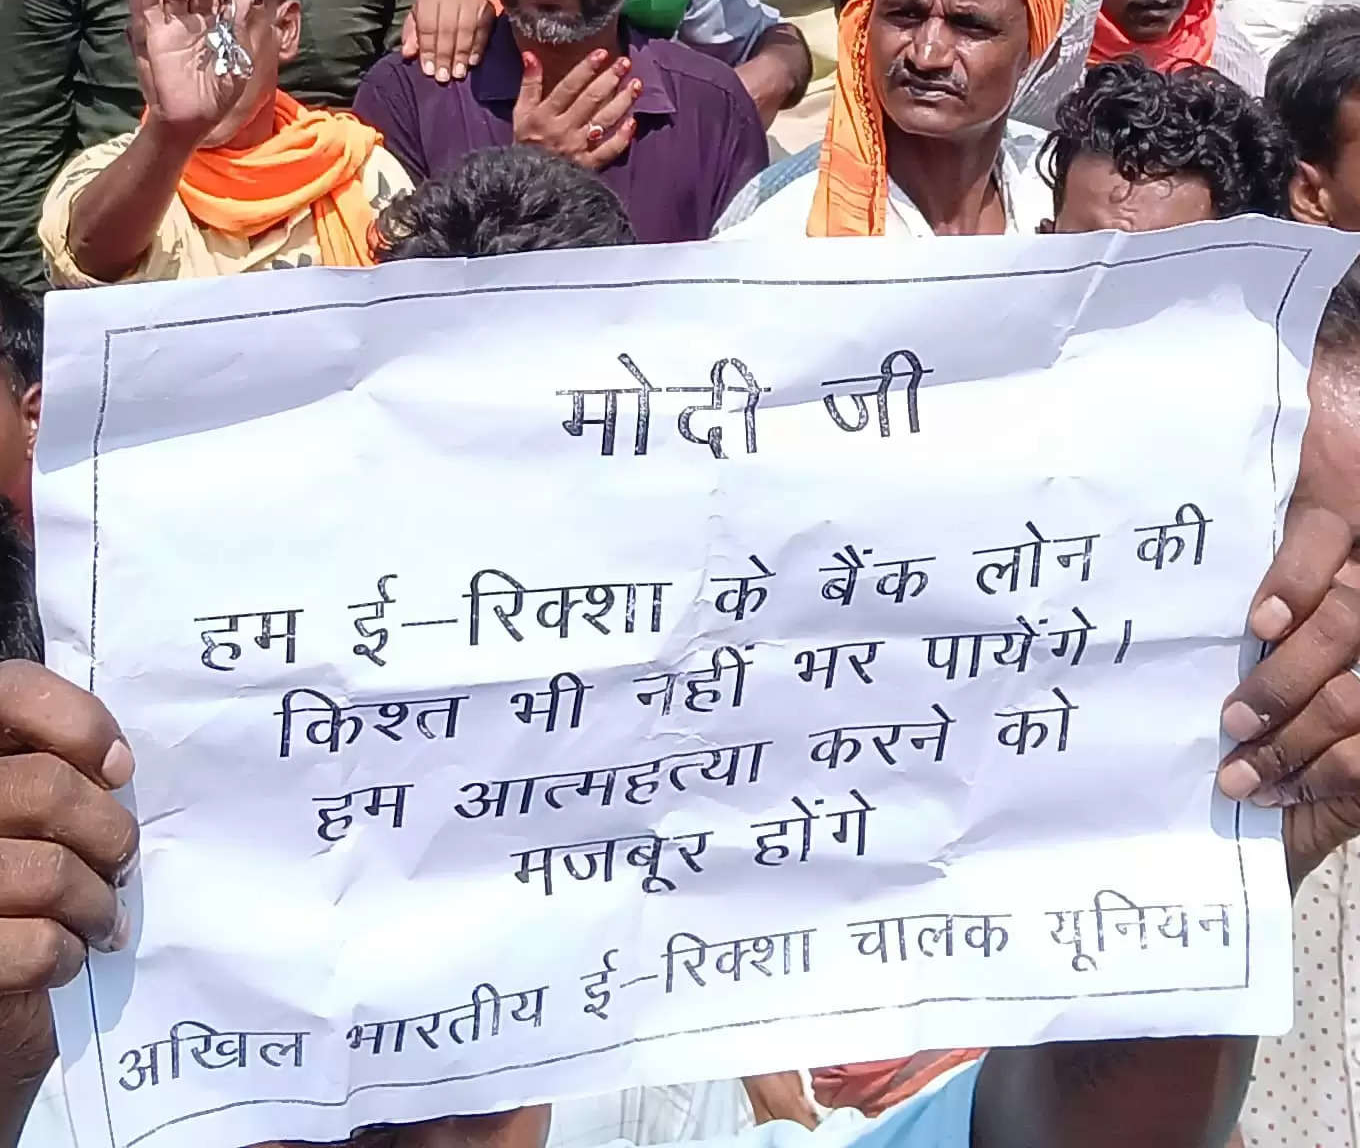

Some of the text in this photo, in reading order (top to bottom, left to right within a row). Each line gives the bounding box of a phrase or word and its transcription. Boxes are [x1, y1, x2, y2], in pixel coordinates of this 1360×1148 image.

[556, 350, 935, 460] मोदी जी
[194, 609, 305, 671] हम
[710, 555, 776, 621] के
[819, 544, 936, 606] बैंक
[972, 521, 1101, 595] लोन
[1134, 503, 1214, 570] की
[273, 686, 469, 757] किश्त
[509, 672, 595, 733] भी
[633, 646, 753, 716] नहीं
[794, 641, 885, 690] भर
[312, 688, 1080, 842] हम आत्महत्या करने को
[510, 789, 877, 896] मजबूर होंगे
[119, 1021, 311, 1092] अखिल
[346, 982, 549, 1055] भारतीय
[847, 914, 1012, 963] चालक
[1045, 889, 1230, 973] यूनियन
